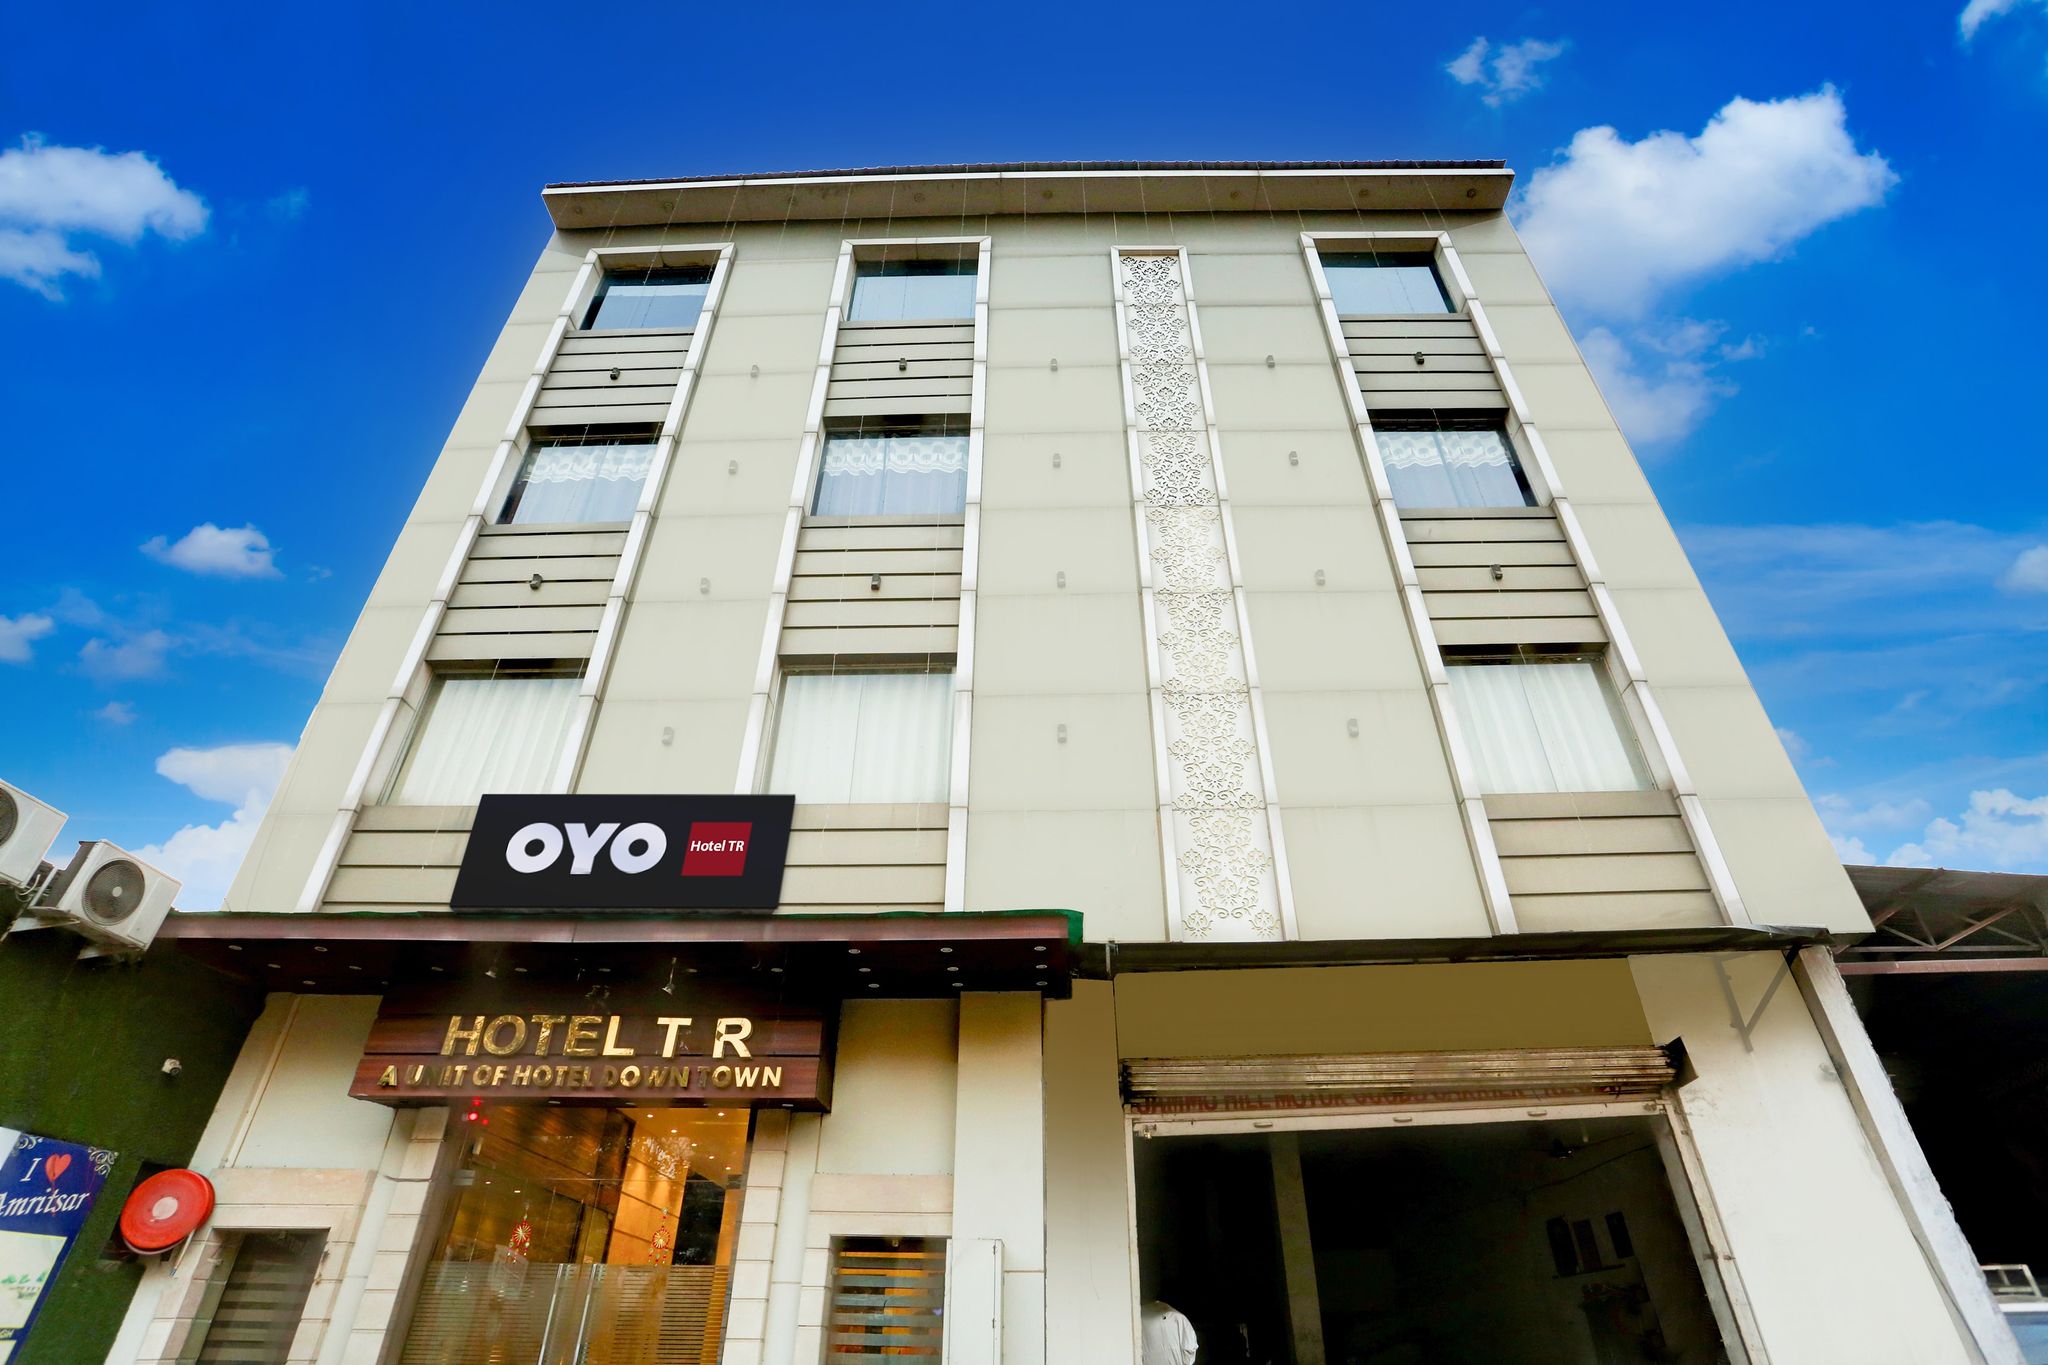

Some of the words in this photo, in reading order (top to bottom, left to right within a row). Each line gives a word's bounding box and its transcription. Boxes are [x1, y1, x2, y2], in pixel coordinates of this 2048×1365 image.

[505, 822, 668, 875] OYO
[690, 840, 726, 852] Hotel
[728, 840, 745, 852] TR
[440, 1015, 636, 1057] HOTEL
[656, 1016, 693, 1058] T
[711, 1016, 753, 1059] R
[377, 1064, 399, 1087] A
[404, 1064, 469, 1087] UNIT
[472, 1064, 508, 1087] OF
[511, 1064, 595, 1088] HOTEL
[602, 1065, 691, 1088] DOWN
[697, 1065, 783, 1088] TOWN
[19, 1157, 43, 1182] I
